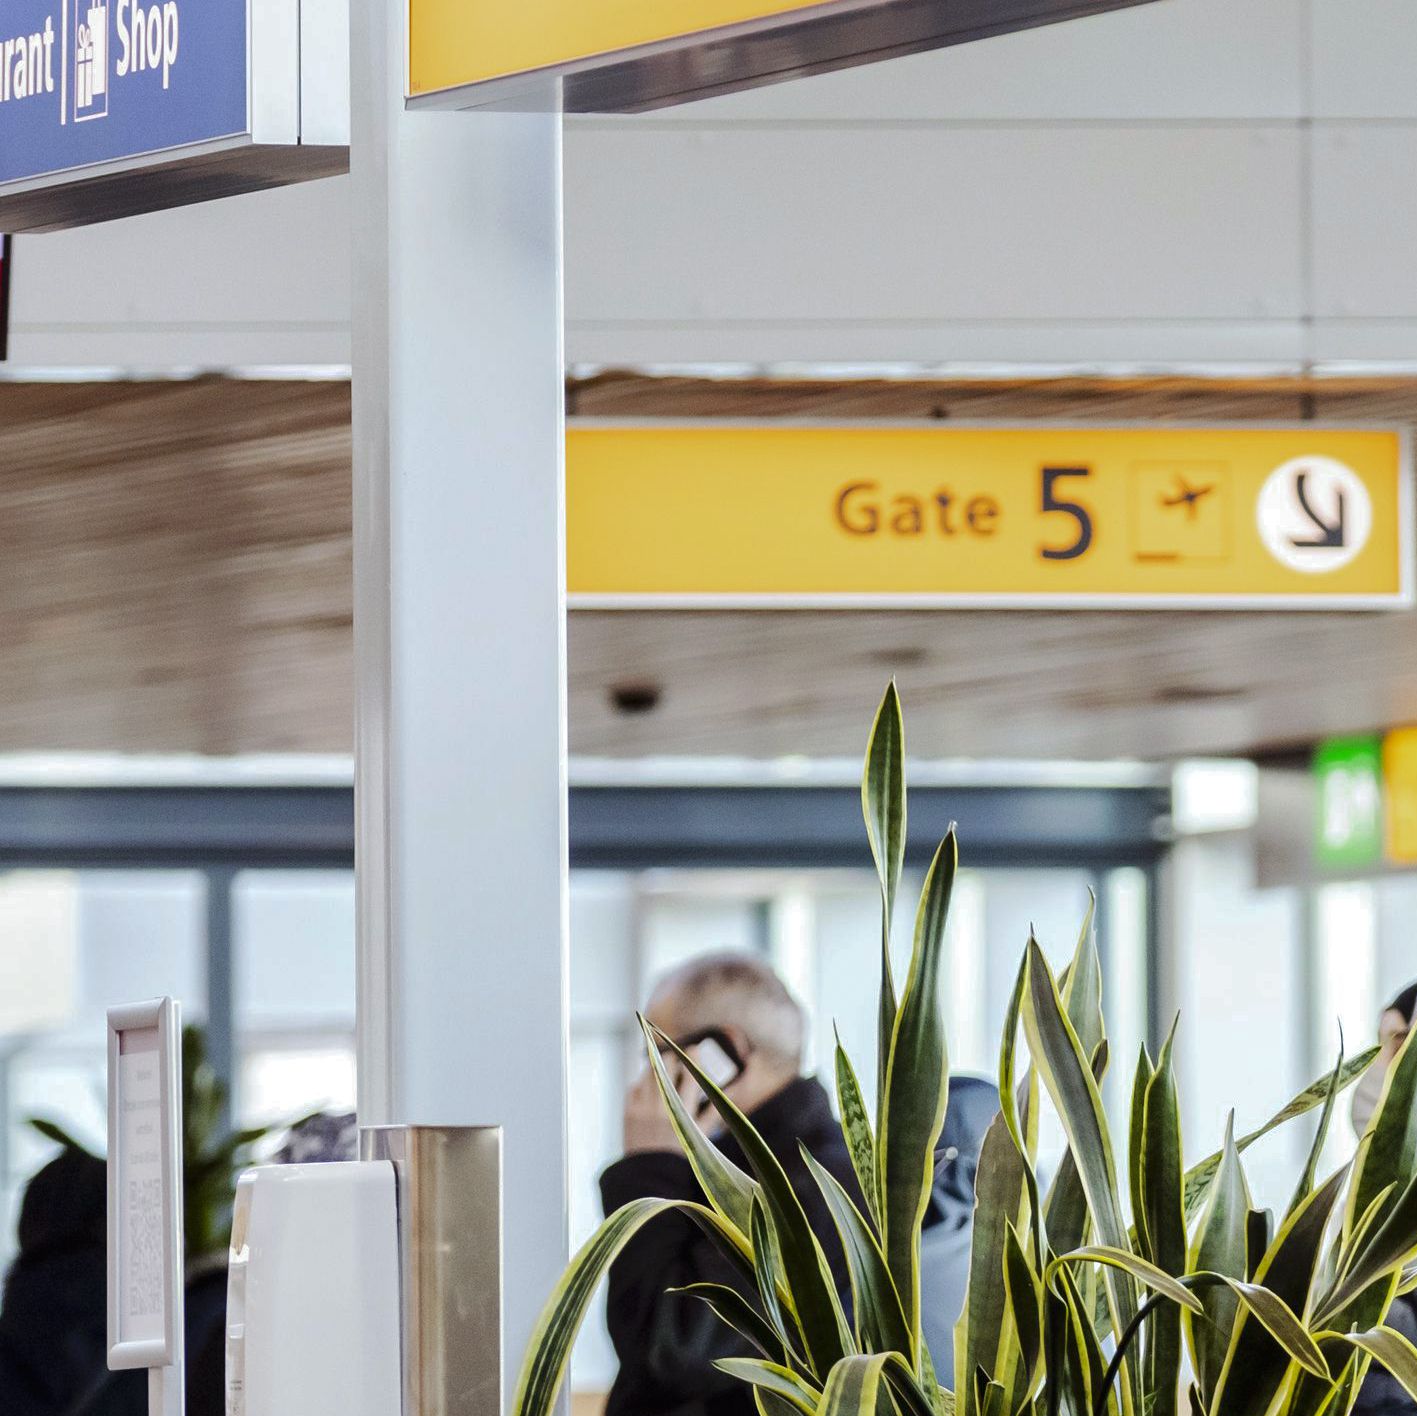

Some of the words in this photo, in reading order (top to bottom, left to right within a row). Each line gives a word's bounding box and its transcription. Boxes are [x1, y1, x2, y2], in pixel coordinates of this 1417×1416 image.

[0, 15, 54, 103] rant
[116, 0, 179, 90] Shop
[834, 481, 999, 536] Gate
[1040, 466, 1094, 561] 5
